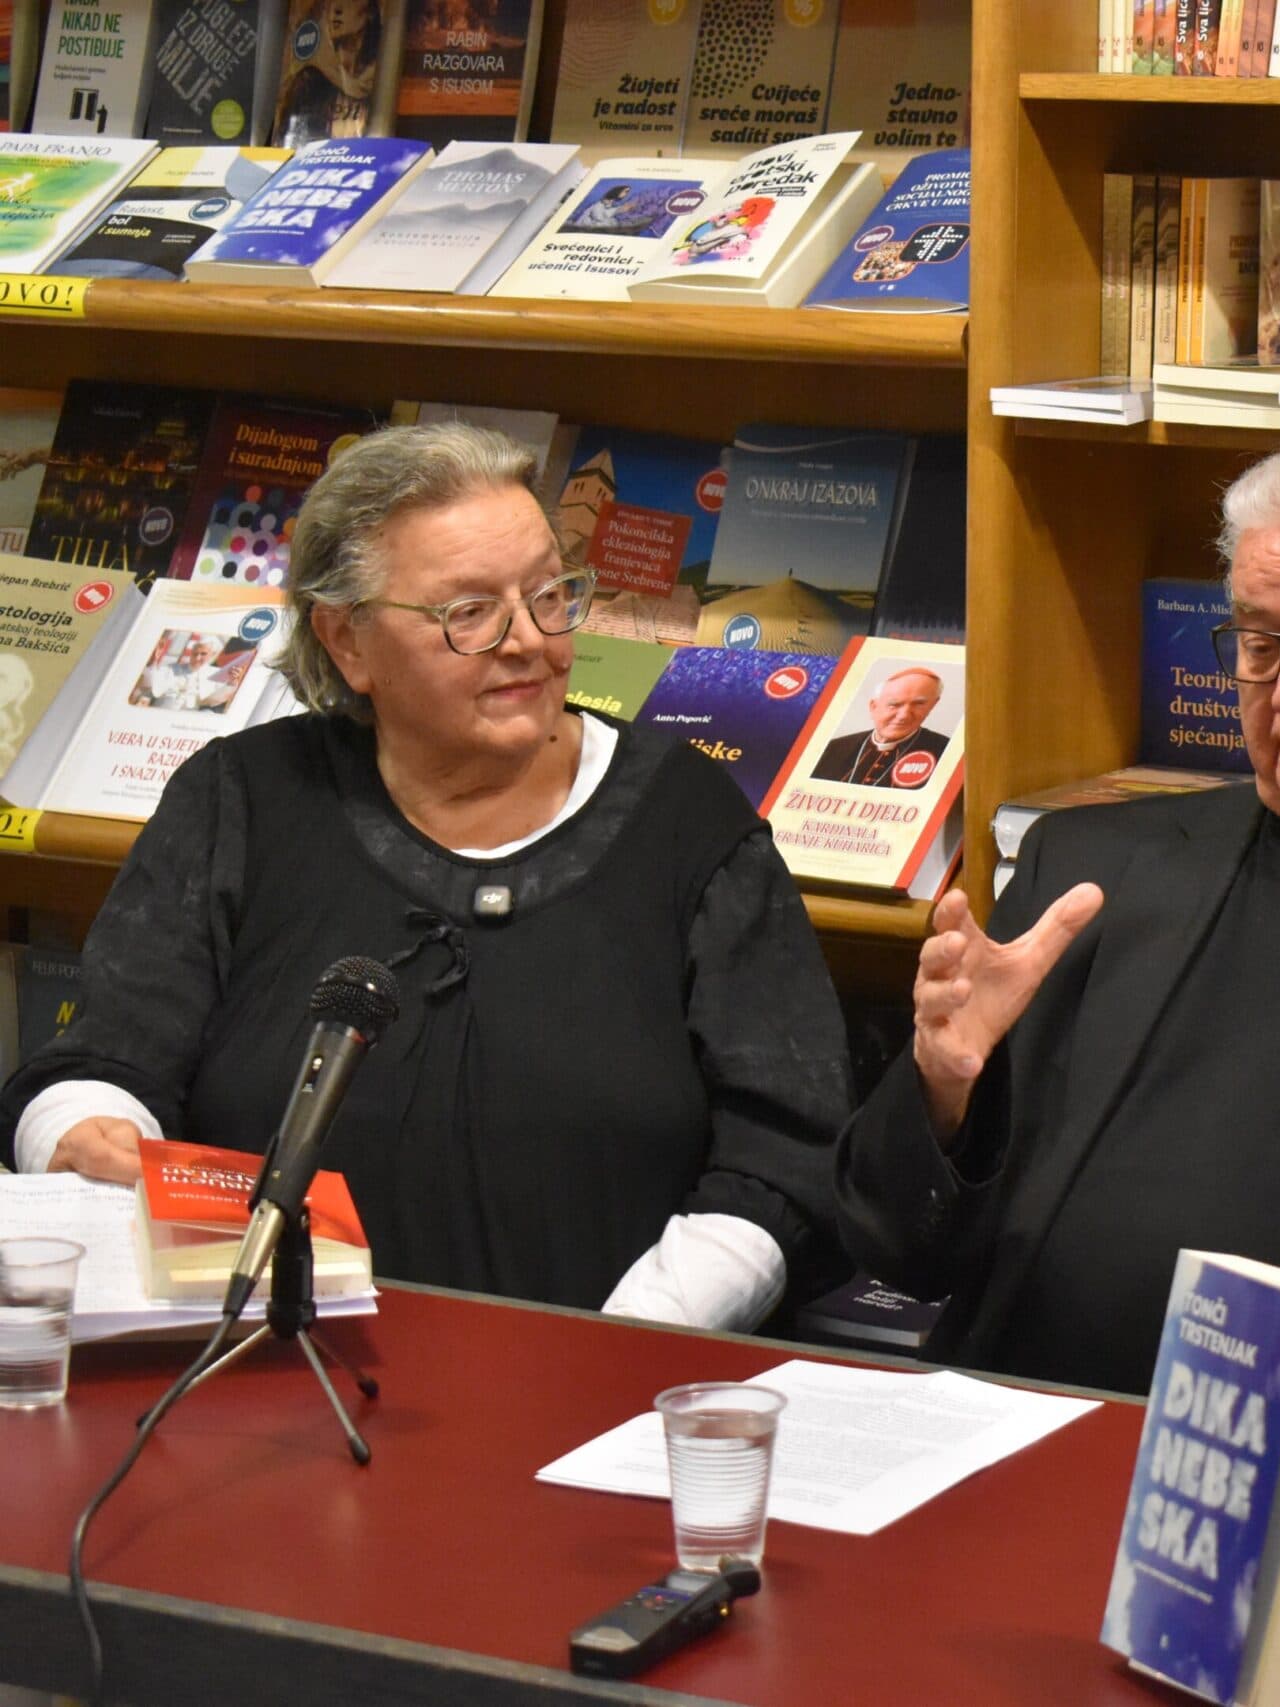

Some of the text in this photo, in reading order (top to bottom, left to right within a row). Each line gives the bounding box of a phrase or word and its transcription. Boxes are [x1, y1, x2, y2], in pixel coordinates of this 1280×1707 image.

[61, 11, 123, 33] NIKAD NE
[1197, 20, 1208, 42] Sva
[445, 31, 488, 48] RABIN
[1175, 22, 1186, 44] Sva
[422, 54, 505, 71] RAZGOVARA
[430, 79, 494, 96] S ISUSOM
[617, 73, 680, 97] Živjeti
[751, 82, 821, 105] Cvijeće
[891, 82, 962, 105] Jedno-
[593, 99, 676, 118] je radost
[699, 104, 818, 124] sreće moraš
[886, 108, 958, 125] stavno
[710, 126, 769, 145] saditi
[874, 129, 958, 147] volim te
[43, 144, 112, 157] FRANJO
[300, 156, 377, 165] TRSTENJAK
[748, 151, 796, 171] novi
[276, 168, 377, 190] DIKA
[442, 170, 525, 183] THOMAS
[723, 171, 820, 199] poredak
[434, 181, 516, 194] MERTON
[256, 189, 362, 210] NEBE
[885, 200, 928, 212] CRKVE
[107, 215, 130, 226] bol
[236, 208, 321, 229] SKA
[104, 226, 152, 239] sumnja
[543, 242, 615, 255] Svećenici
[563, 253, 633, 265] redovnici
[527, 262, 640, 277] učenici Isusovi
[235, 423, 319, 452] Dijalogom
[236, 452, 324, 476] suradnjom
[744, 478, 878, 507] ONKRAJ IZAZOVA
[608, 519, 675, 545] Pokoncilska
[601, 536, 672, 561] ekleziologija
[603, 551, 661, 572] franjevaca
[30, 578, 71, 592] Brebrić
[1157, 599, 1209, 613] Barbara A.
[729, 625, 754, 643] NOVO
[15, 637, 71, 655] Bakšića
[1169, 666, 1239, 695] Teorije
[1169, 695, 1242, 719] društve
[652, 713, 713, 725] Anto Popović
[107, 730, 159, 748] VJERA U
[1168, 724, 1246, 751] sjećanja
[119, 765, 157, 782] SNAZI
[784, 788, 846, 817] ŽIVOT
[857, 802, 920, 825] DJELO
[773, 830, 822, 849] FRANJE
[801, 818, 880, 841] KARDINALA
[1183, 1291, 1228, 1327] TONČI
[1179, 1317, 1260, 1369] TRSTENJAK
[1162, 1360, 1267, 1455] DIKA
[1150, 1431, 1258, 1521] NEBE
[1136, 1492, 1219, 1581] SKA
